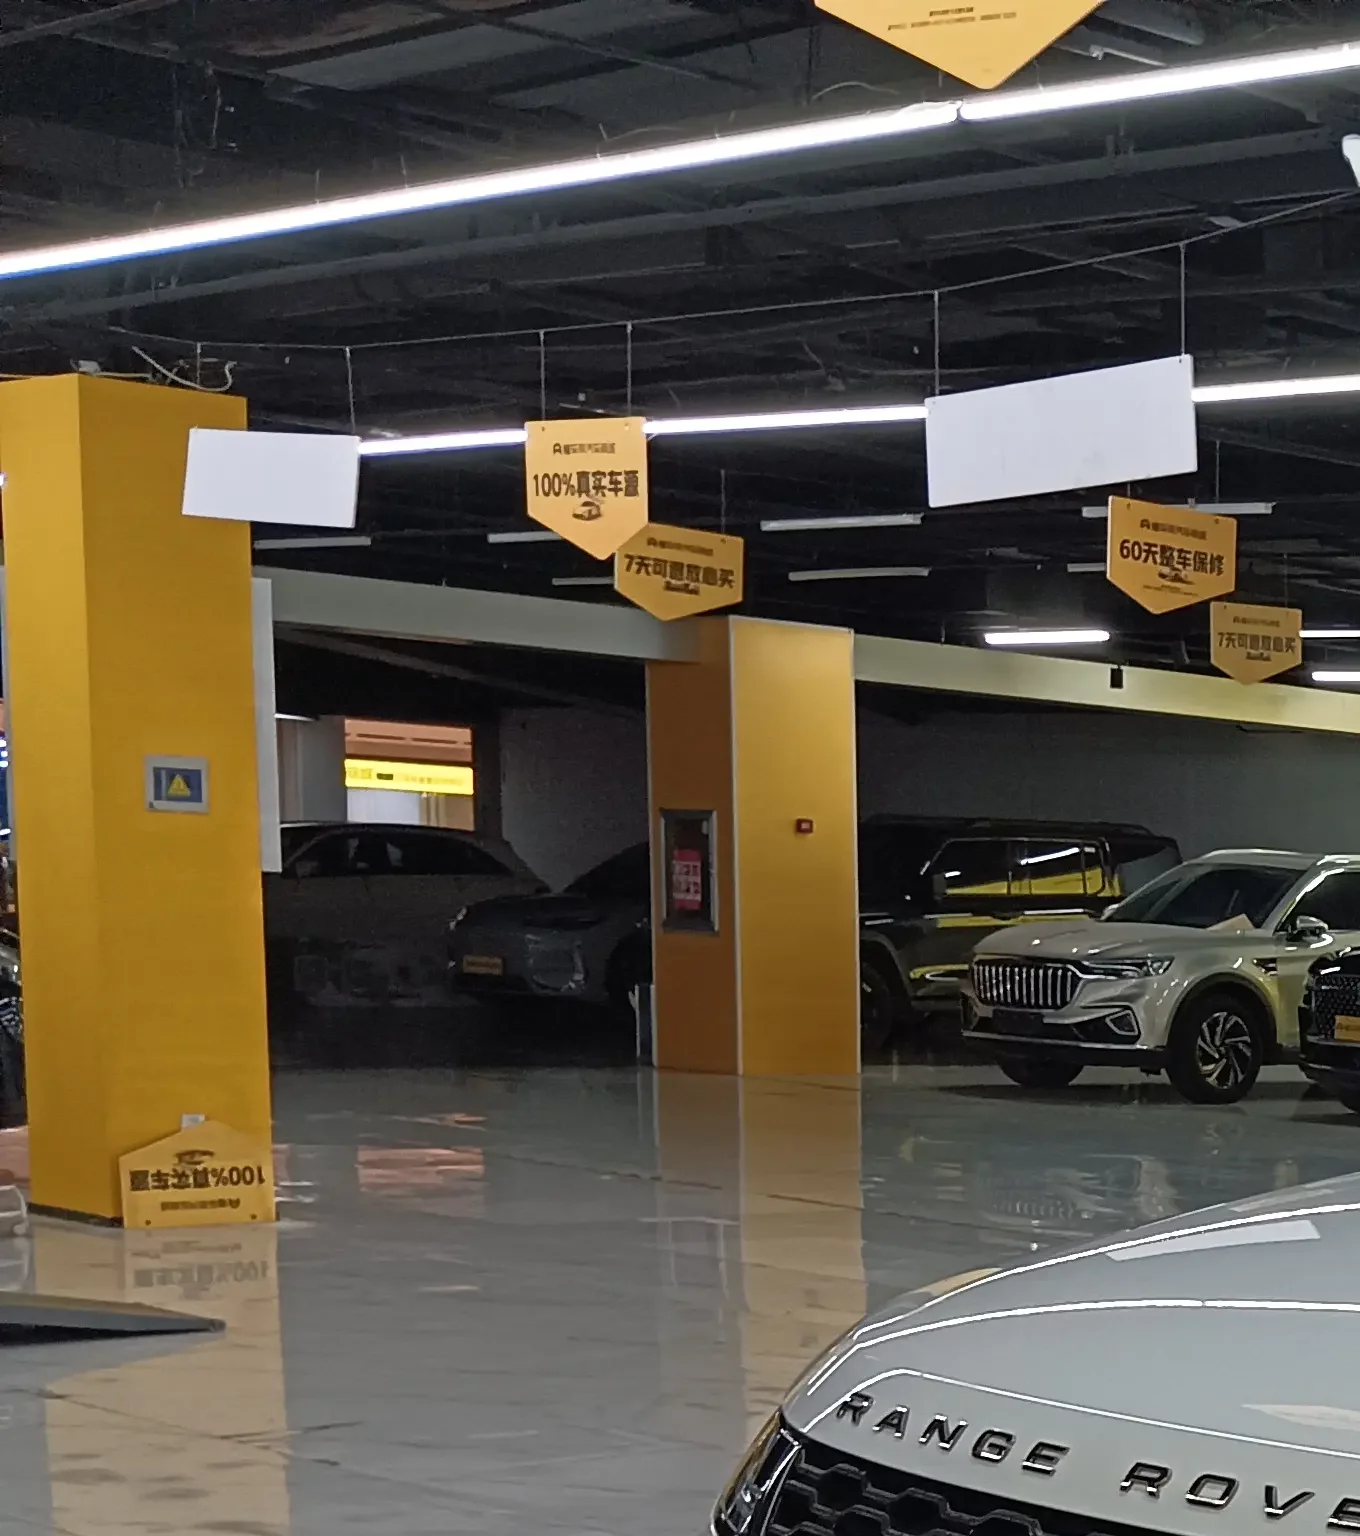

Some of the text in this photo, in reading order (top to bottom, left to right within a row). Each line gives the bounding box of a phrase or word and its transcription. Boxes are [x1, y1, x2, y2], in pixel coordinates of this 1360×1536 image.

[1119, 538, 1225, 576] 60天整车保修
[836, 1390, 1070, 1476] RANGE
